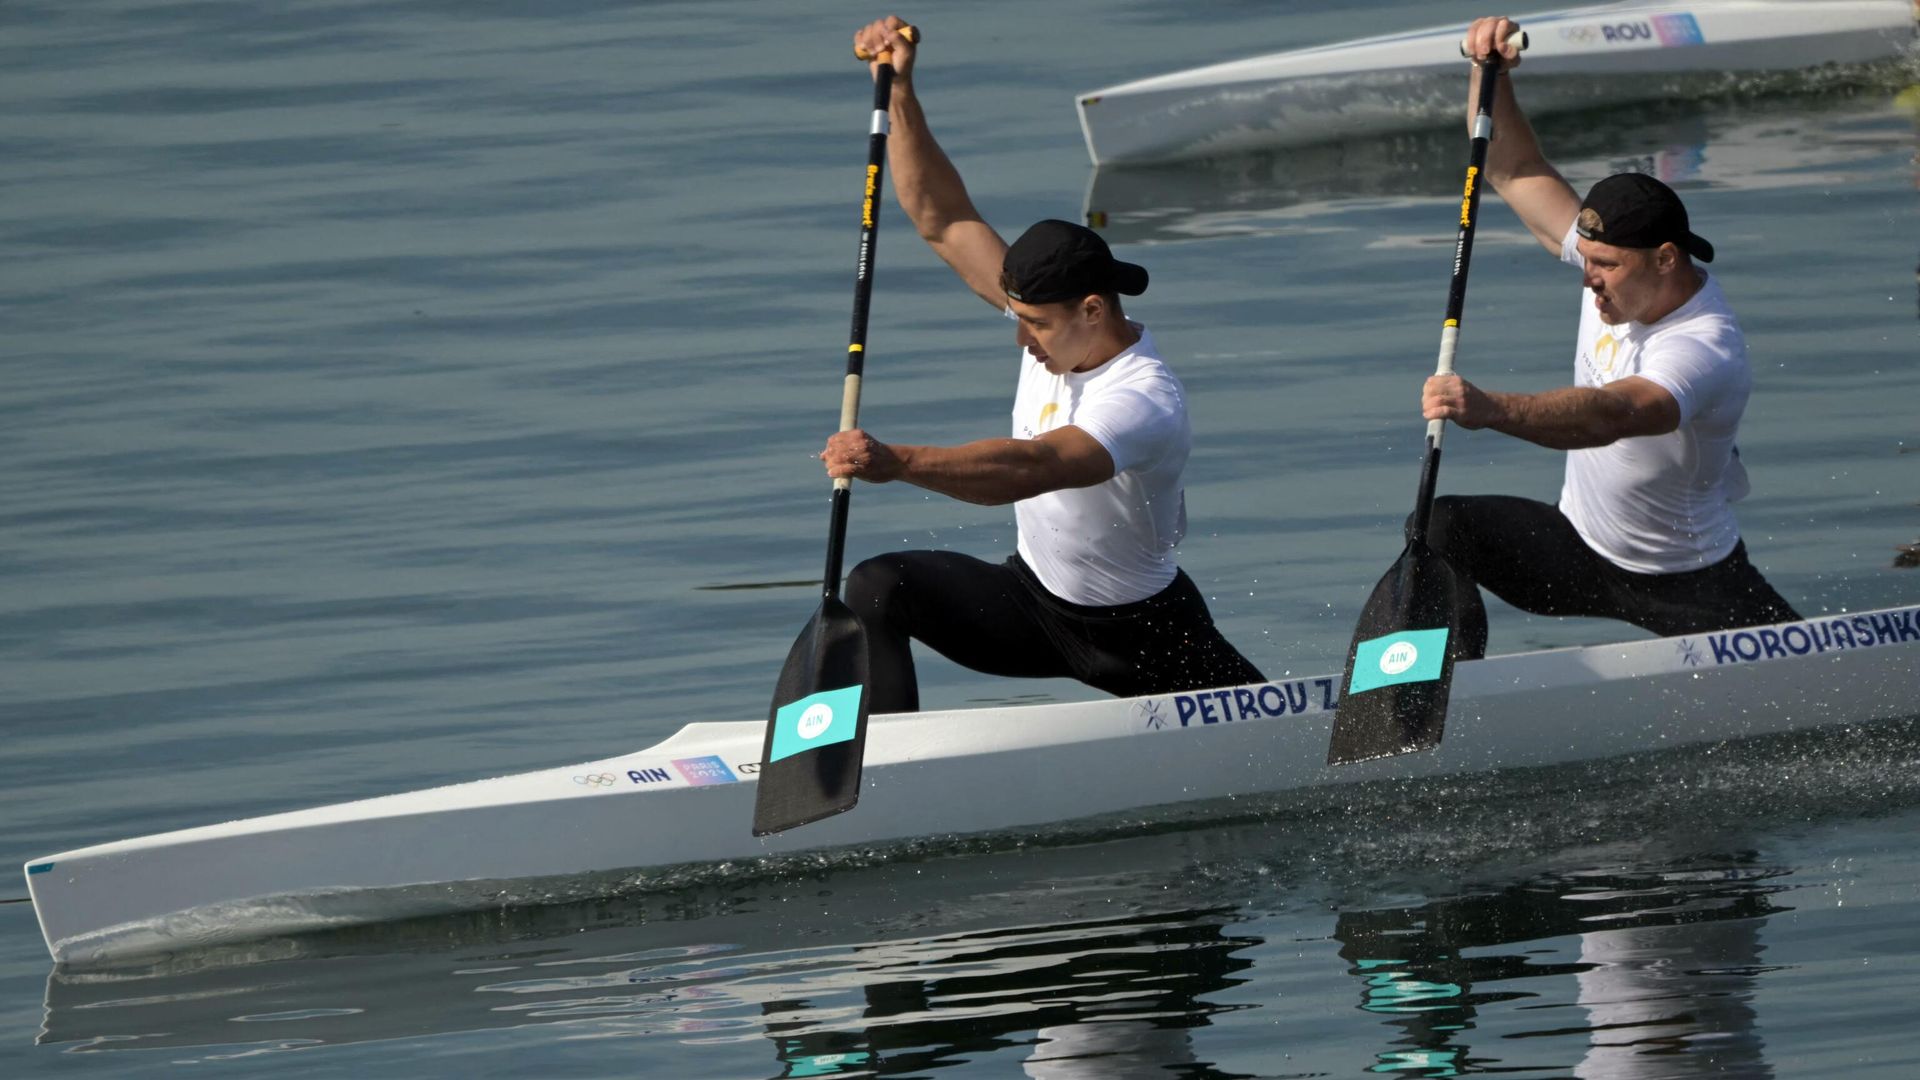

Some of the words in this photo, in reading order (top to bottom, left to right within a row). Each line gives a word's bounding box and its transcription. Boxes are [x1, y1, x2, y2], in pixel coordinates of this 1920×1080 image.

[1601, 21, 1652, 41] ROU
[1708, 611, 1920, 664] KOROVASHK
[1388, 651, 1408, 665] AIN
[805, 713, 824, 728] AIN
[682, 760, 721, 771] PARIS
[689, 768, 727, 778] 2024
[627, 768, 673, 784] AIN
